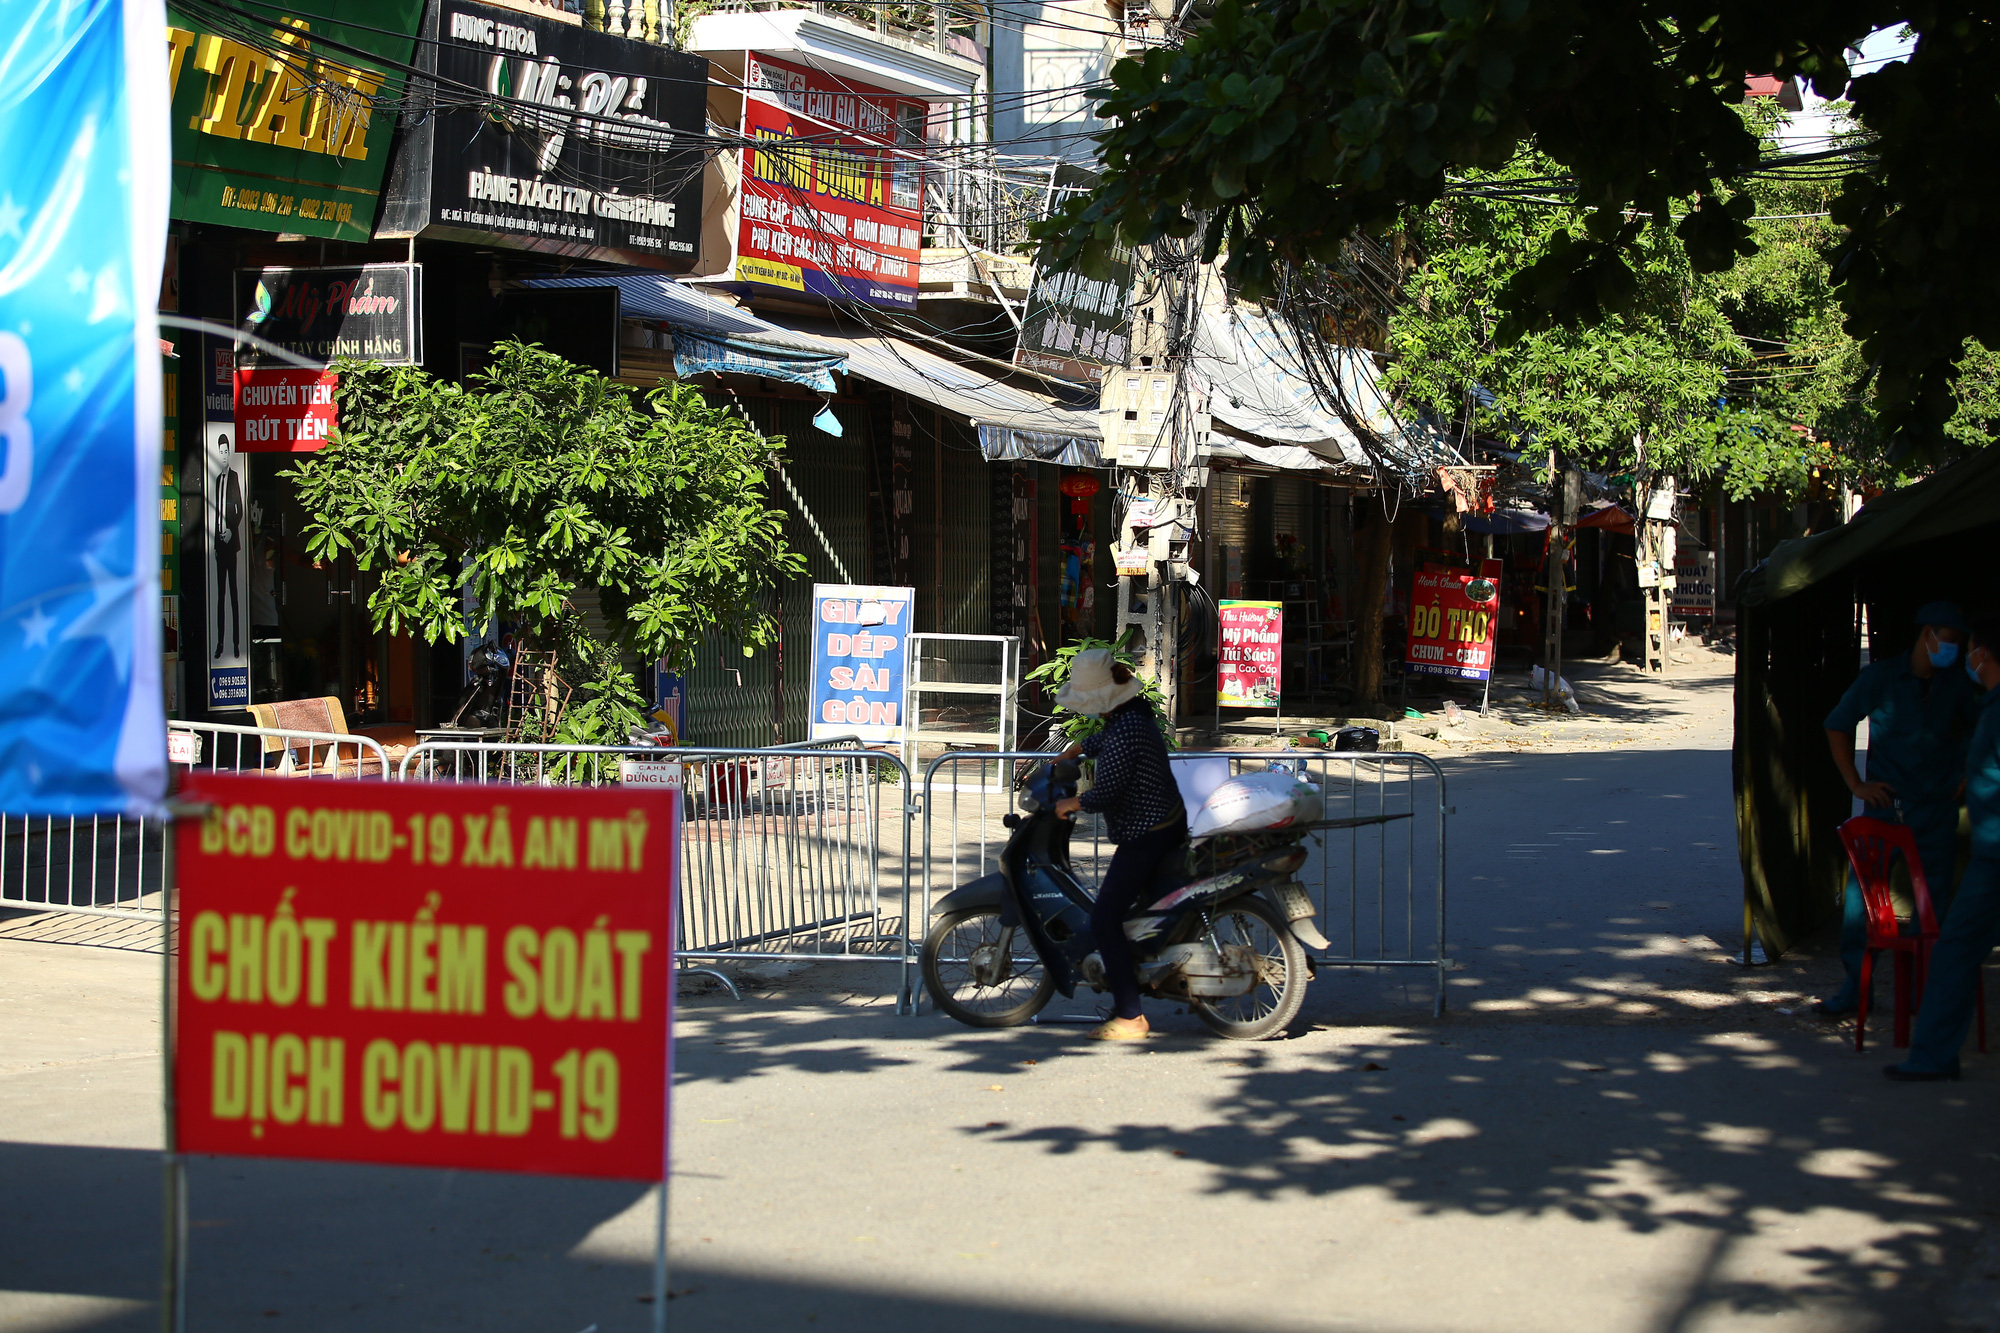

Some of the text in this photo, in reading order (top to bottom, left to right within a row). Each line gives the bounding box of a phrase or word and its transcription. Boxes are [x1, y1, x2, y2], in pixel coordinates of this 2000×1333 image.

[498, 22, 537, 55] THOA
[192, 17, 385, 161] TÂM
[807, 87, 889, 136] CAO GIA PHÁT
[753, 123, 884, 208] NHÔM ĐÔNG Á
[237, 188, 260, 211] 0983
[260, 192, 278, 213] 996
[298, 198, 320, 219] 0982
[320, 201, 337, 221] 730
[336, 202, 353, 223] 036
[469, 166, 517, 204] HÀNG
[519, 175, 563, 212] XÁCH
[563, 186, 592, 215] TAY
[593, 187, 636, 223] CHÍNH
[743, 194, 768, 220] CUNG
[820, 209, 847, 236] THANH
[854, 216, 878, 244] NHÔM
[879, 223, 899, 250] ĐỊNH
[900, 223, 919, 250] HÌNH
[751, 226, 769, 256] PHỤ
[880, 254, 909, 278] XINGFA
[327, 277, 400, 316] Phẩm
[290, 341, 314, 355] TAY
[318, 336, 360, 355] CHÍNH
[364, 334, 402, 355] HÃNG
[242, 377, 332, 406] CHUYỂN TIỀN
[246, 411, 328, 441] RÚT TIỀN
[821, 598, 905, 625] GIY
[1223, 610, 1237, 622] Thu
[1412, 593, 1491, 644] ĐỒ THỜ
[828, 631, 897, 659] DÉP
[1223, 624, 1279, 646] Mỹ Phẩm
[1222, 646, 1275, 662] Túi Sách
[1239, 663, 1278, 675] Cao Cấp
[1412, 644, 1445, 660] CHUM
[1456, 646, 1487, 667] CHẬU
[829, 663, 890, 691] SÀI
[1428, 665, 1442, 674] 098
[1445, 667, 1459, 675] 867
[1461, 669, 1480, 678] 0029
[823, 696, 897, 725] GÒN
[626, 771, 679, 786] DỪNG LẠI
[201, 804, 649, 872] BCĐ COVID-19 XÃ AN MỸ
[189, 886, 652, 1022] CHỐT KIỂM SOÁT
[212, 1030, 619, 1143] DỊCH COVID-19
